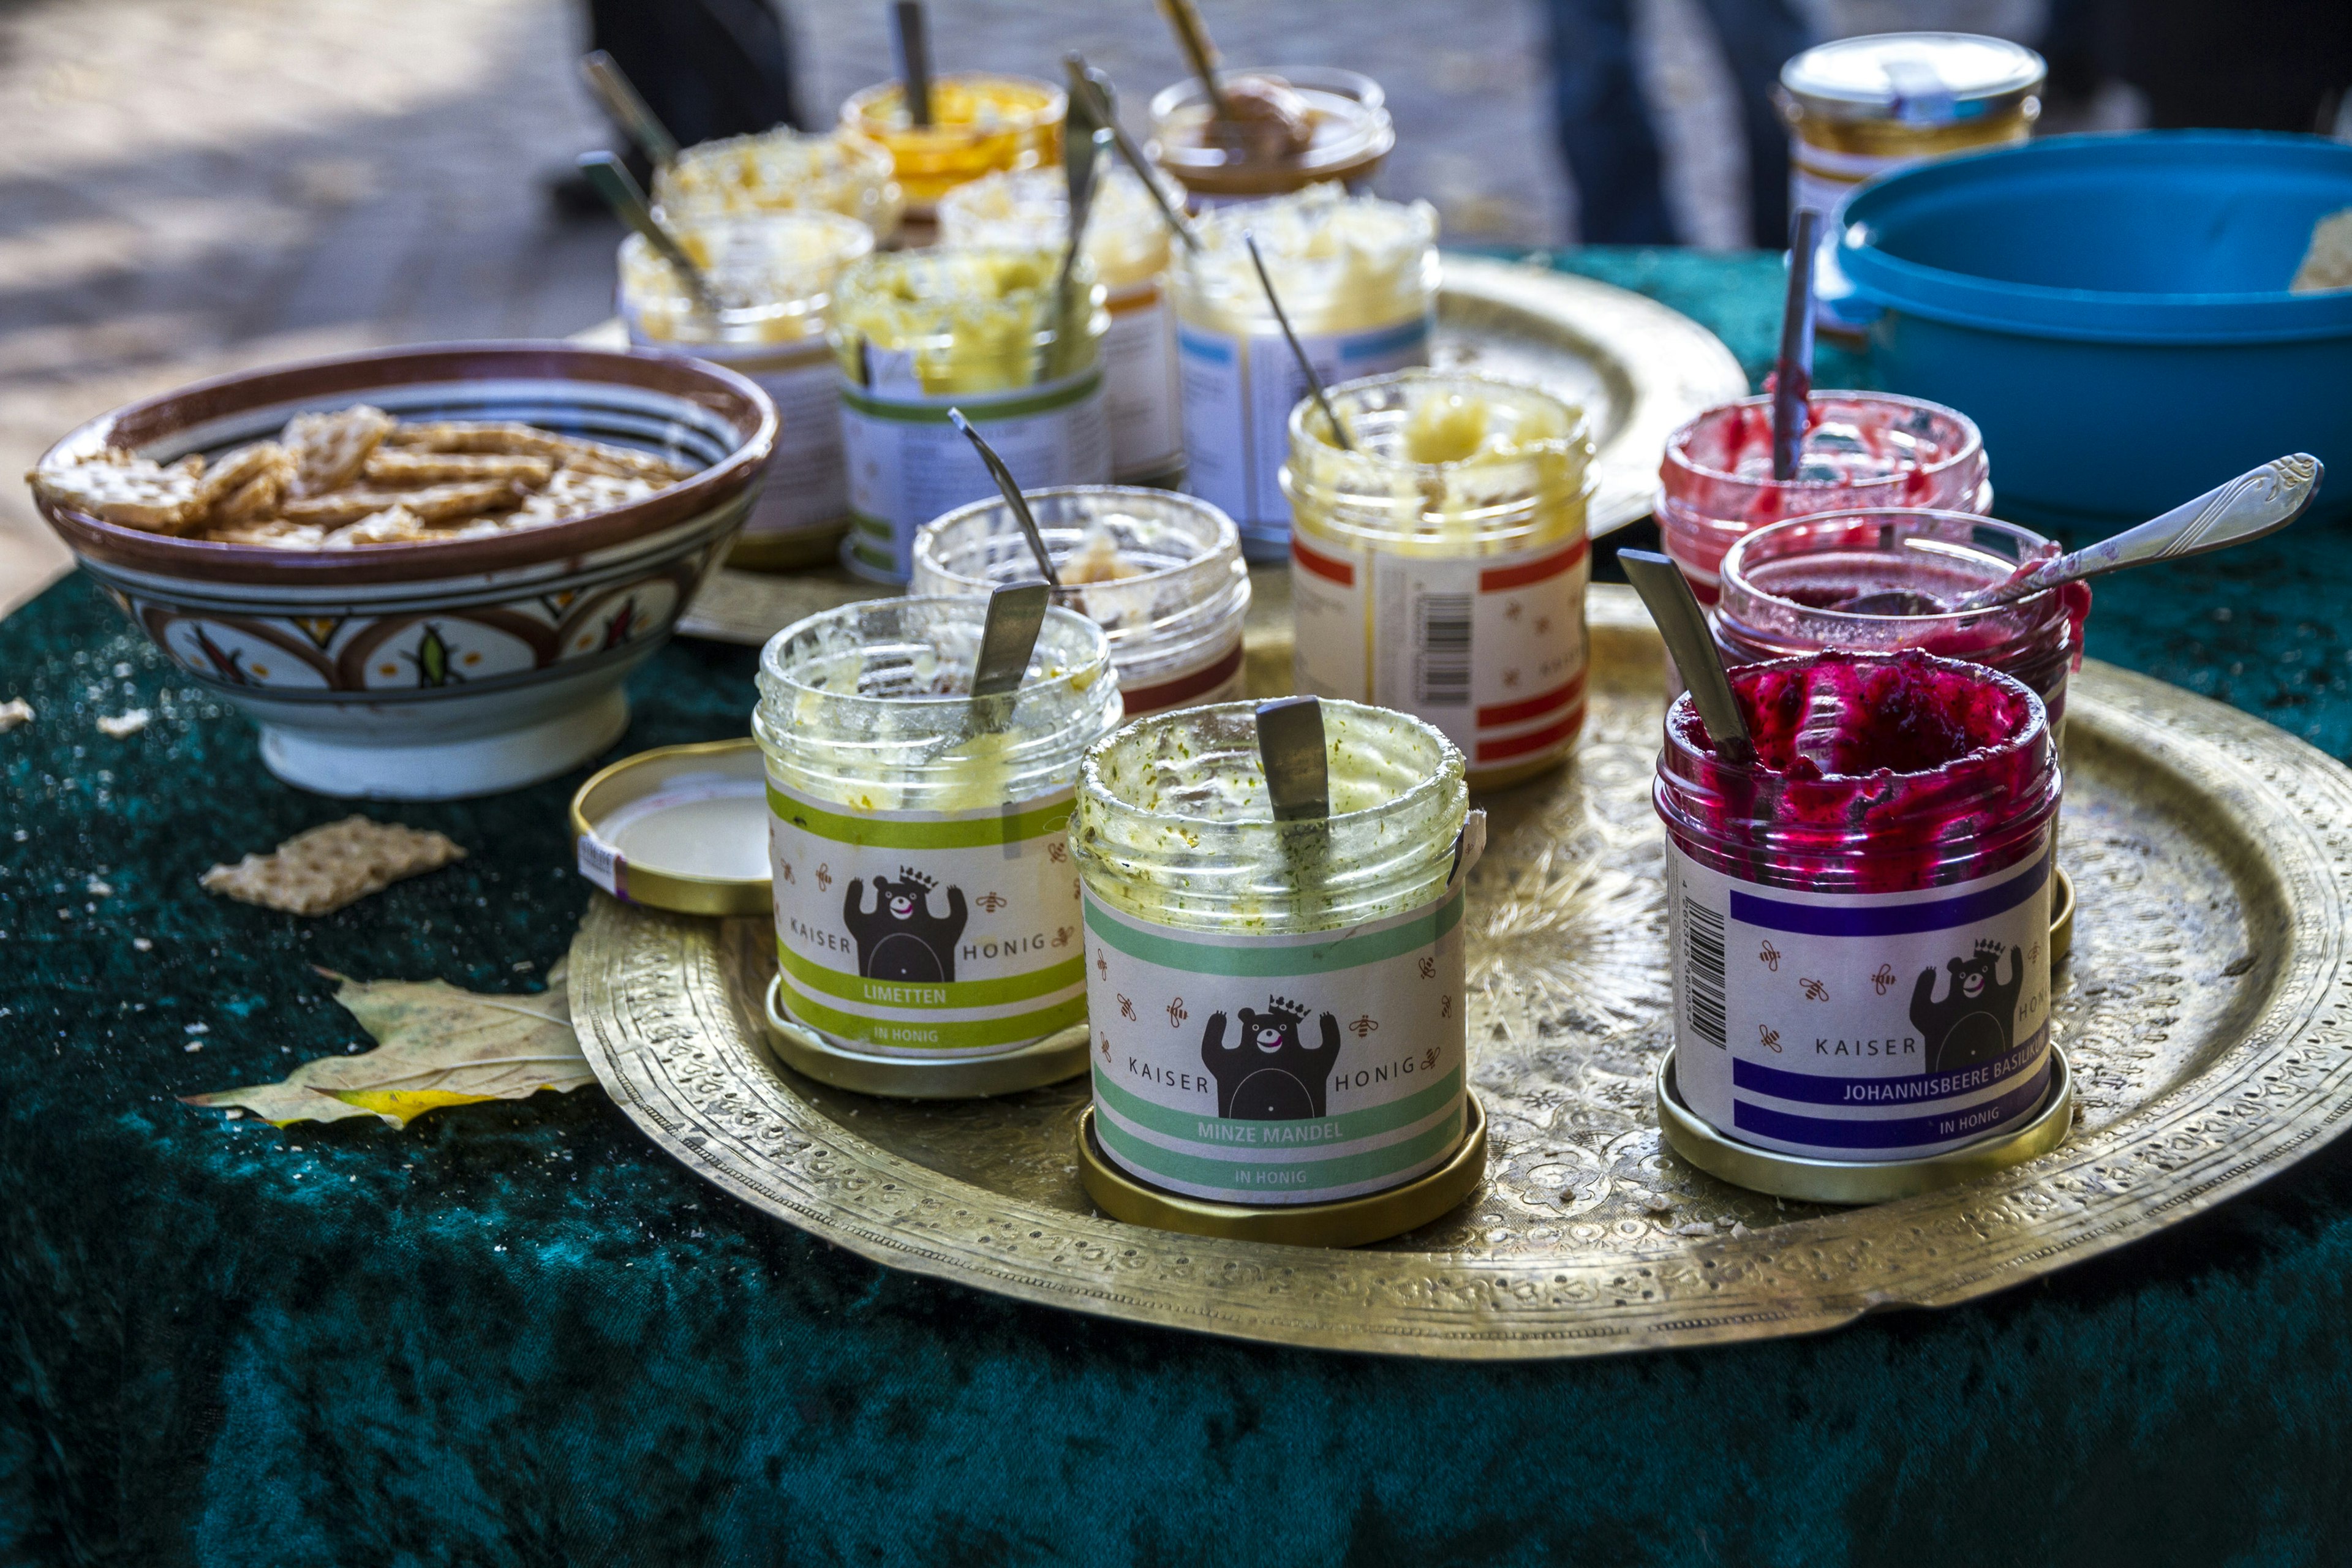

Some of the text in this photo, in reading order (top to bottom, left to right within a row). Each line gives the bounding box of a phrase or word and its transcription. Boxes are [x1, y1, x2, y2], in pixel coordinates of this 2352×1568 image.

[1682, 880, 1688, 889] 4
[1681, 897, 1691, 957] 260345
[790, 916, 1045, 961] KAISER HONIG
[864, 984, 946, 1004] LIMETTEN
[874, 1026, 939, 1042] IN HONIG
[1815, 1037, 1916, 1057] KAISER
[1129, 1056, 1415, 1094] KAISER HONIG
[1843, 1067, 1989, 1101] JOHANNISBEERE
[1198, 1121, 1343, 1143] MINZE MANDEL
[1940, 1107, 2000, 1135] IN HONIG
[1235, 1170, 1307, 1184] IN HONIG
